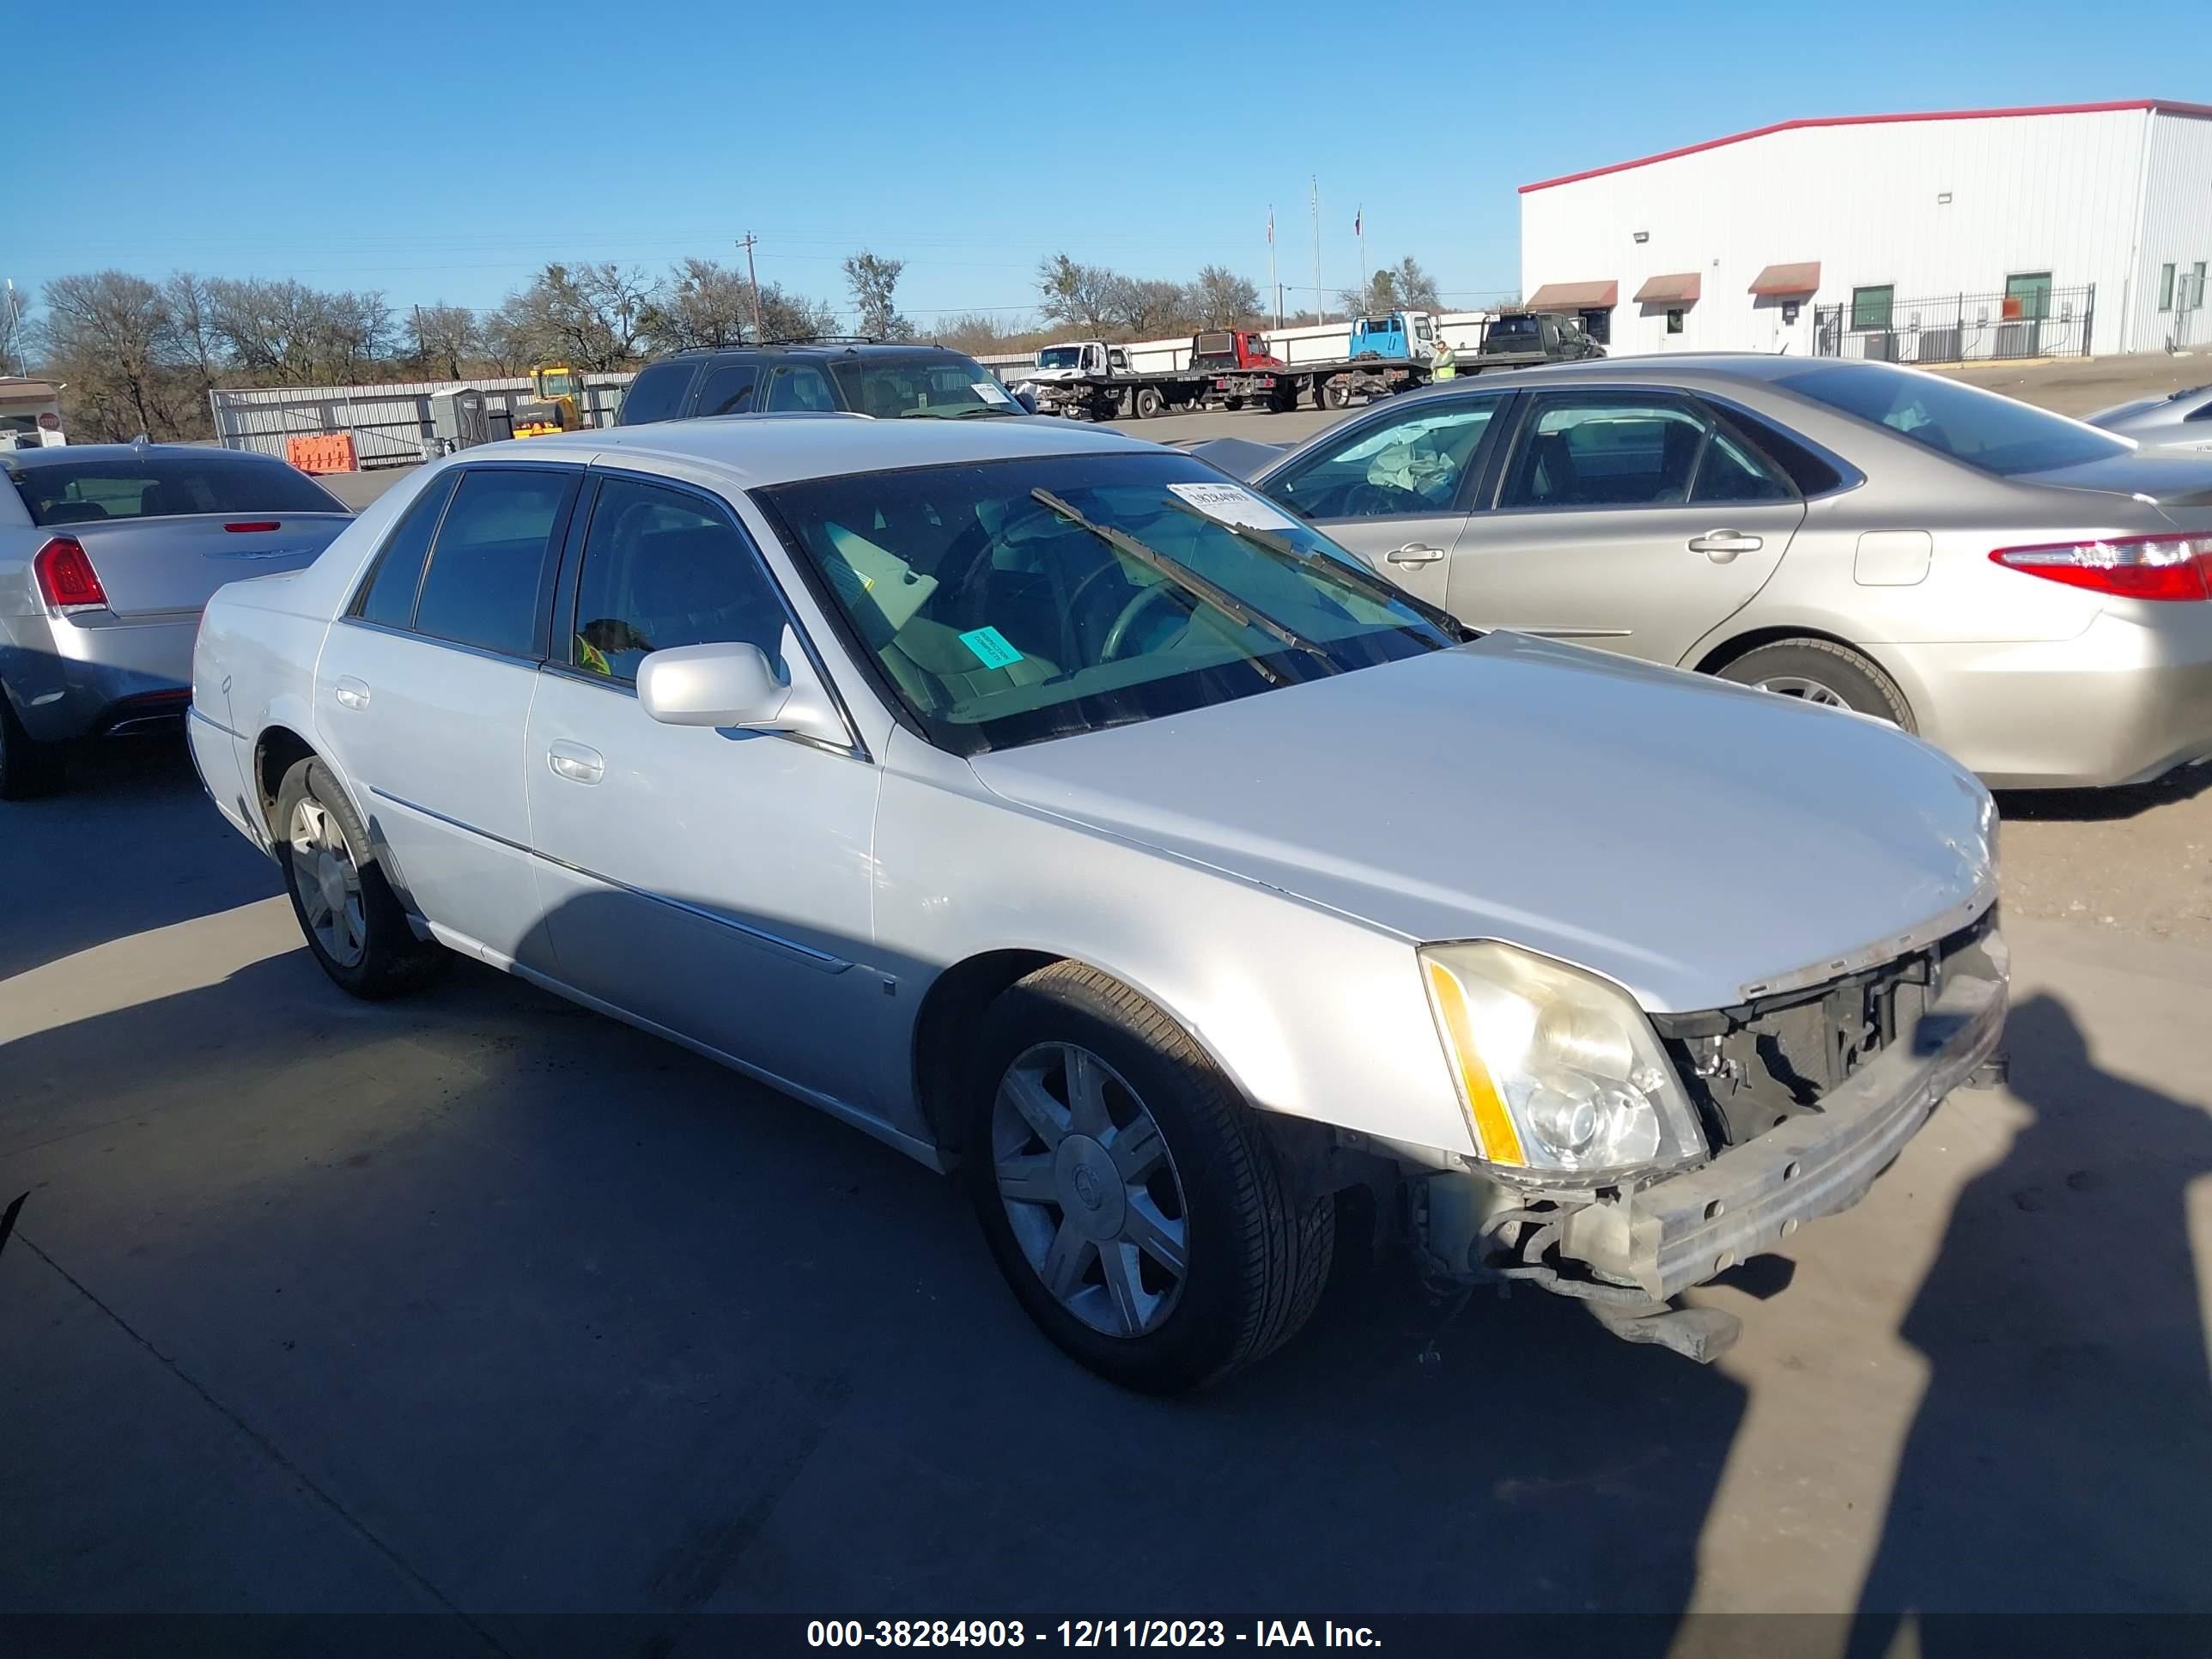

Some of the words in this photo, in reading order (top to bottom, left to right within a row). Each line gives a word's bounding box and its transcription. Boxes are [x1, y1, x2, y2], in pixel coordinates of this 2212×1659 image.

[40, 418, 59, 427] STOP
[974, 635, 1003, 661] COMPLETE
[979, 631, 1011, 660] INSPECTION
